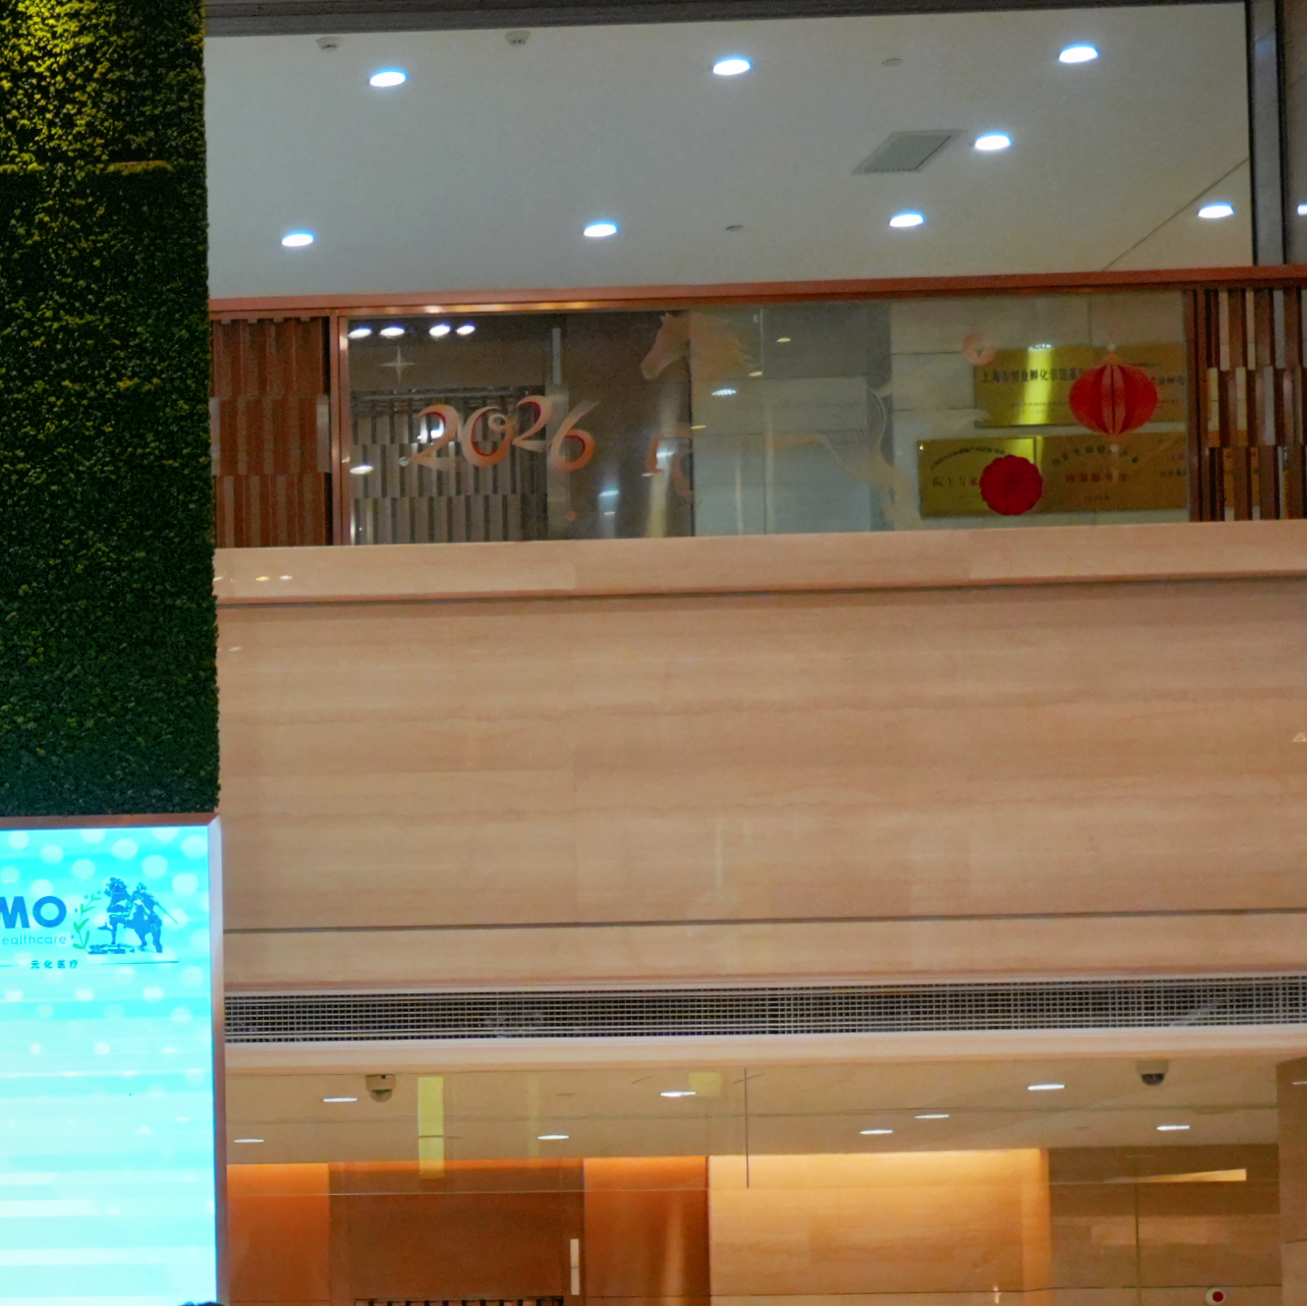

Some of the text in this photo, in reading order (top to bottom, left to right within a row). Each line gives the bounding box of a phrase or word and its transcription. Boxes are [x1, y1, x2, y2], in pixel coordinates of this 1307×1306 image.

[409, 395, 599, 472] 2026
[30, 959, 79, 970] 元化医疗
